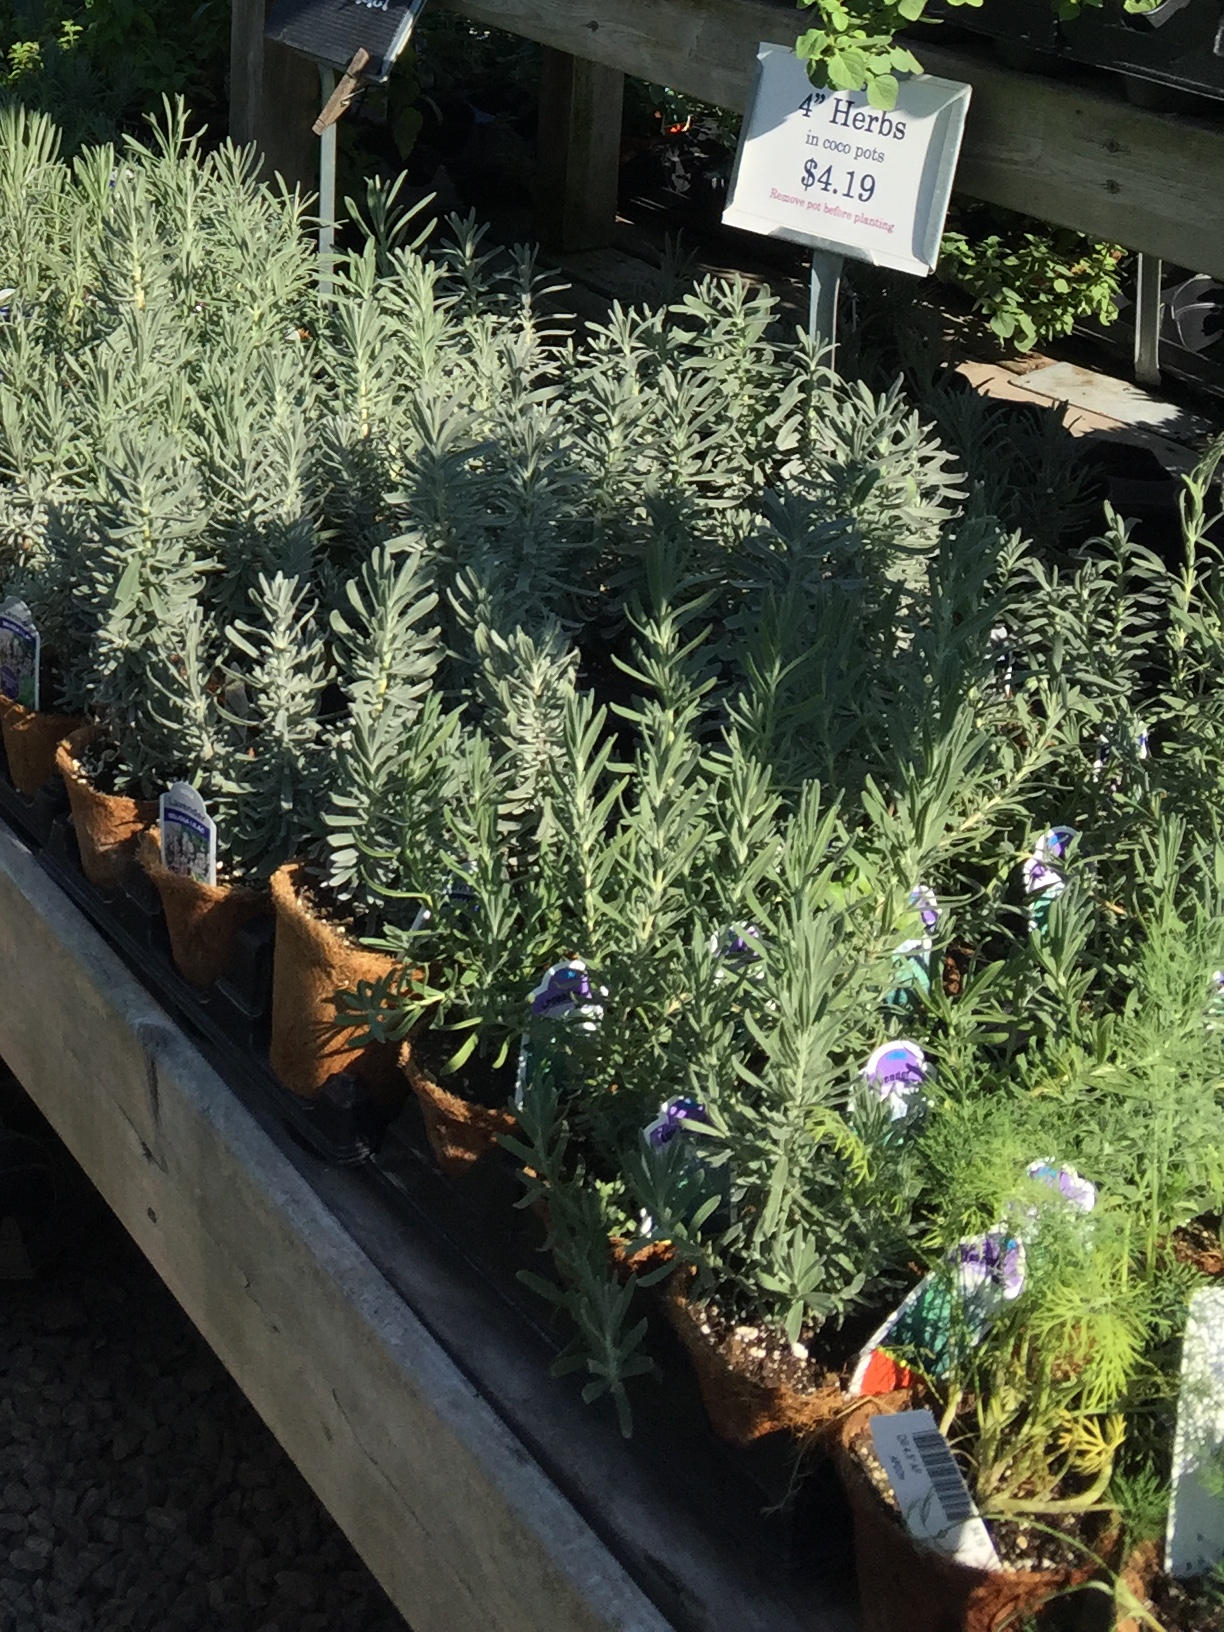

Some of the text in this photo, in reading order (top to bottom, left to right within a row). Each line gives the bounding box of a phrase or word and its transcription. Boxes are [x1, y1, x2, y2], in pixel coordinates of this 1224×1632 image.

[829, 97, 907, 140] Herbs
[805, 129, 885, 163] in coco pots
[801, 157, 876, 203] $4.19
[770, 188, 895, 234] Remove pot before planting
